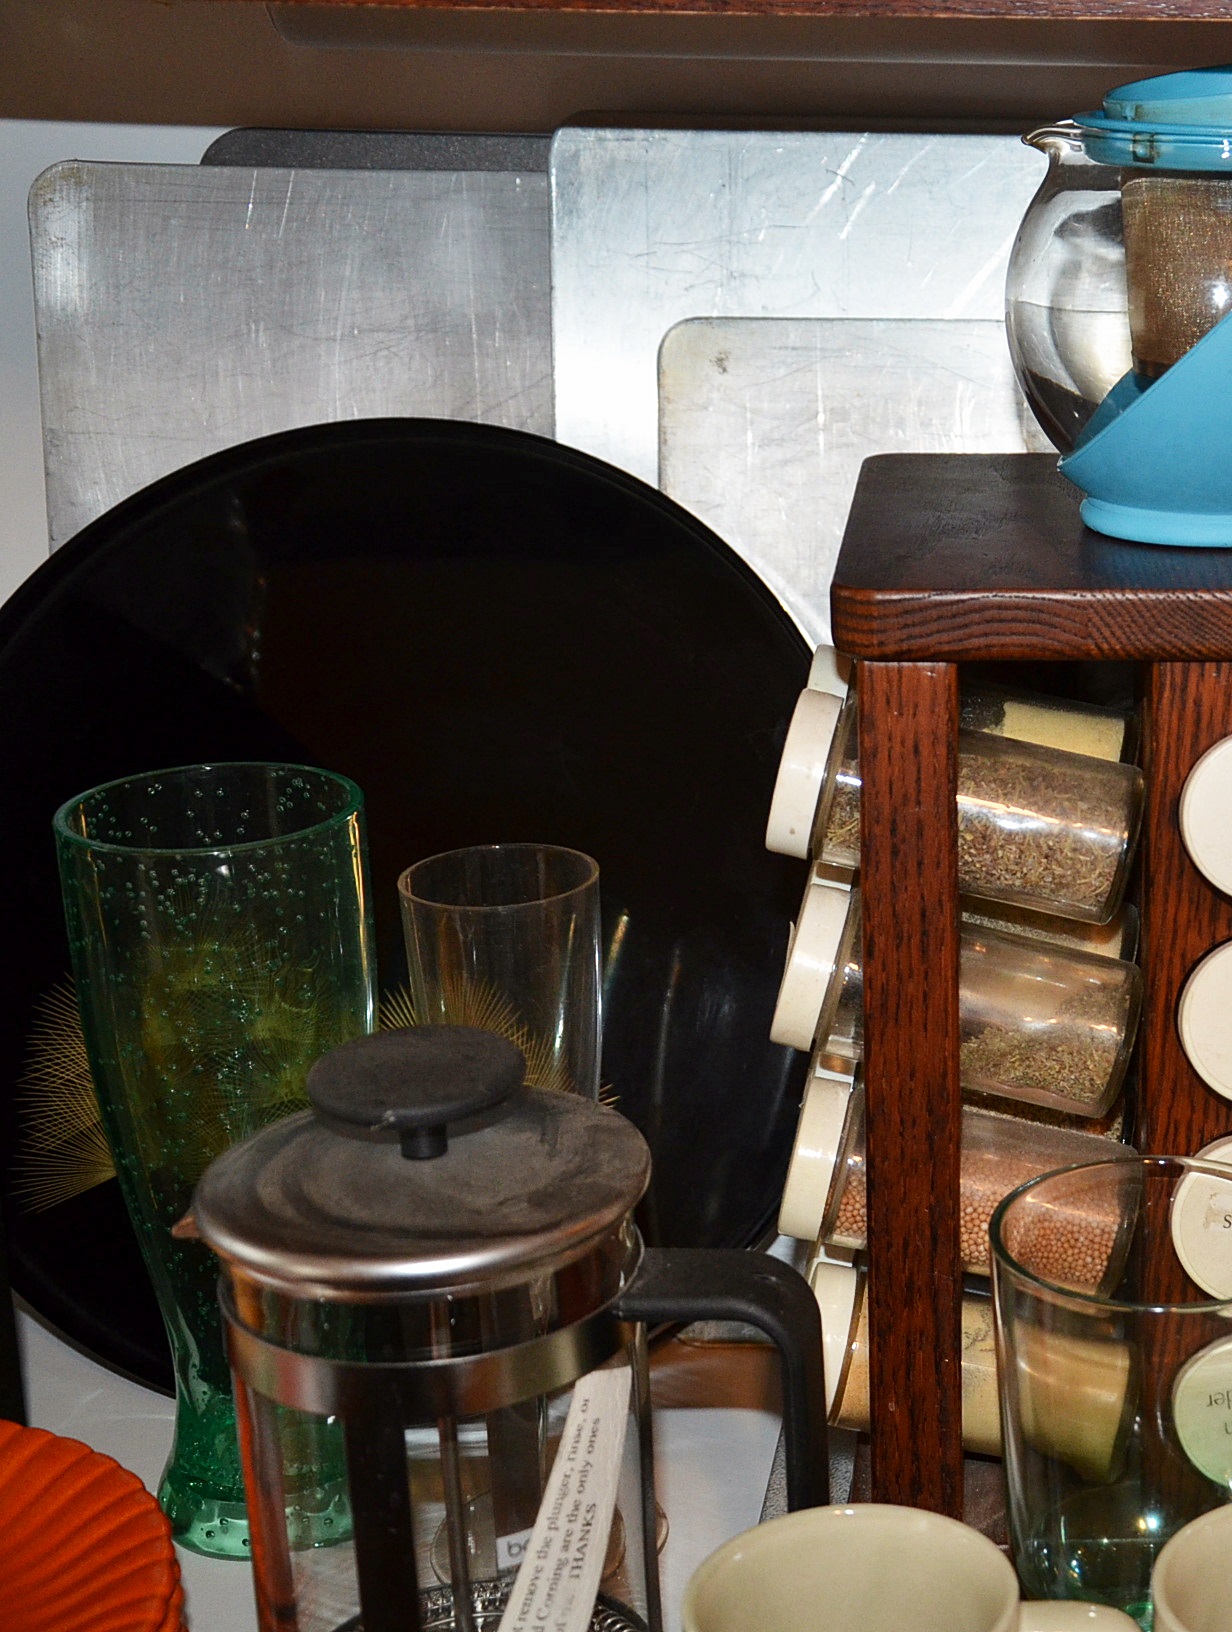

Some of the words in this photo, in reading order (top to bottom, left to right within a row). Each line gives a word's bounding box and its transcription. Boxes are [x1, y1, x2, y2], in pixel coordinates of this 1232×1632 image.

[586, 1417, 600, 1454] ones
[576, 1460, 593, 1494] only
[566, 1499, 582, 1524] the
[561, 1529, 573, 1553] are
[568, 1502, 597, 1579] THANKS
[518, 1564, 544, 1622] remove
[536, 1536, 553, 1560] the
